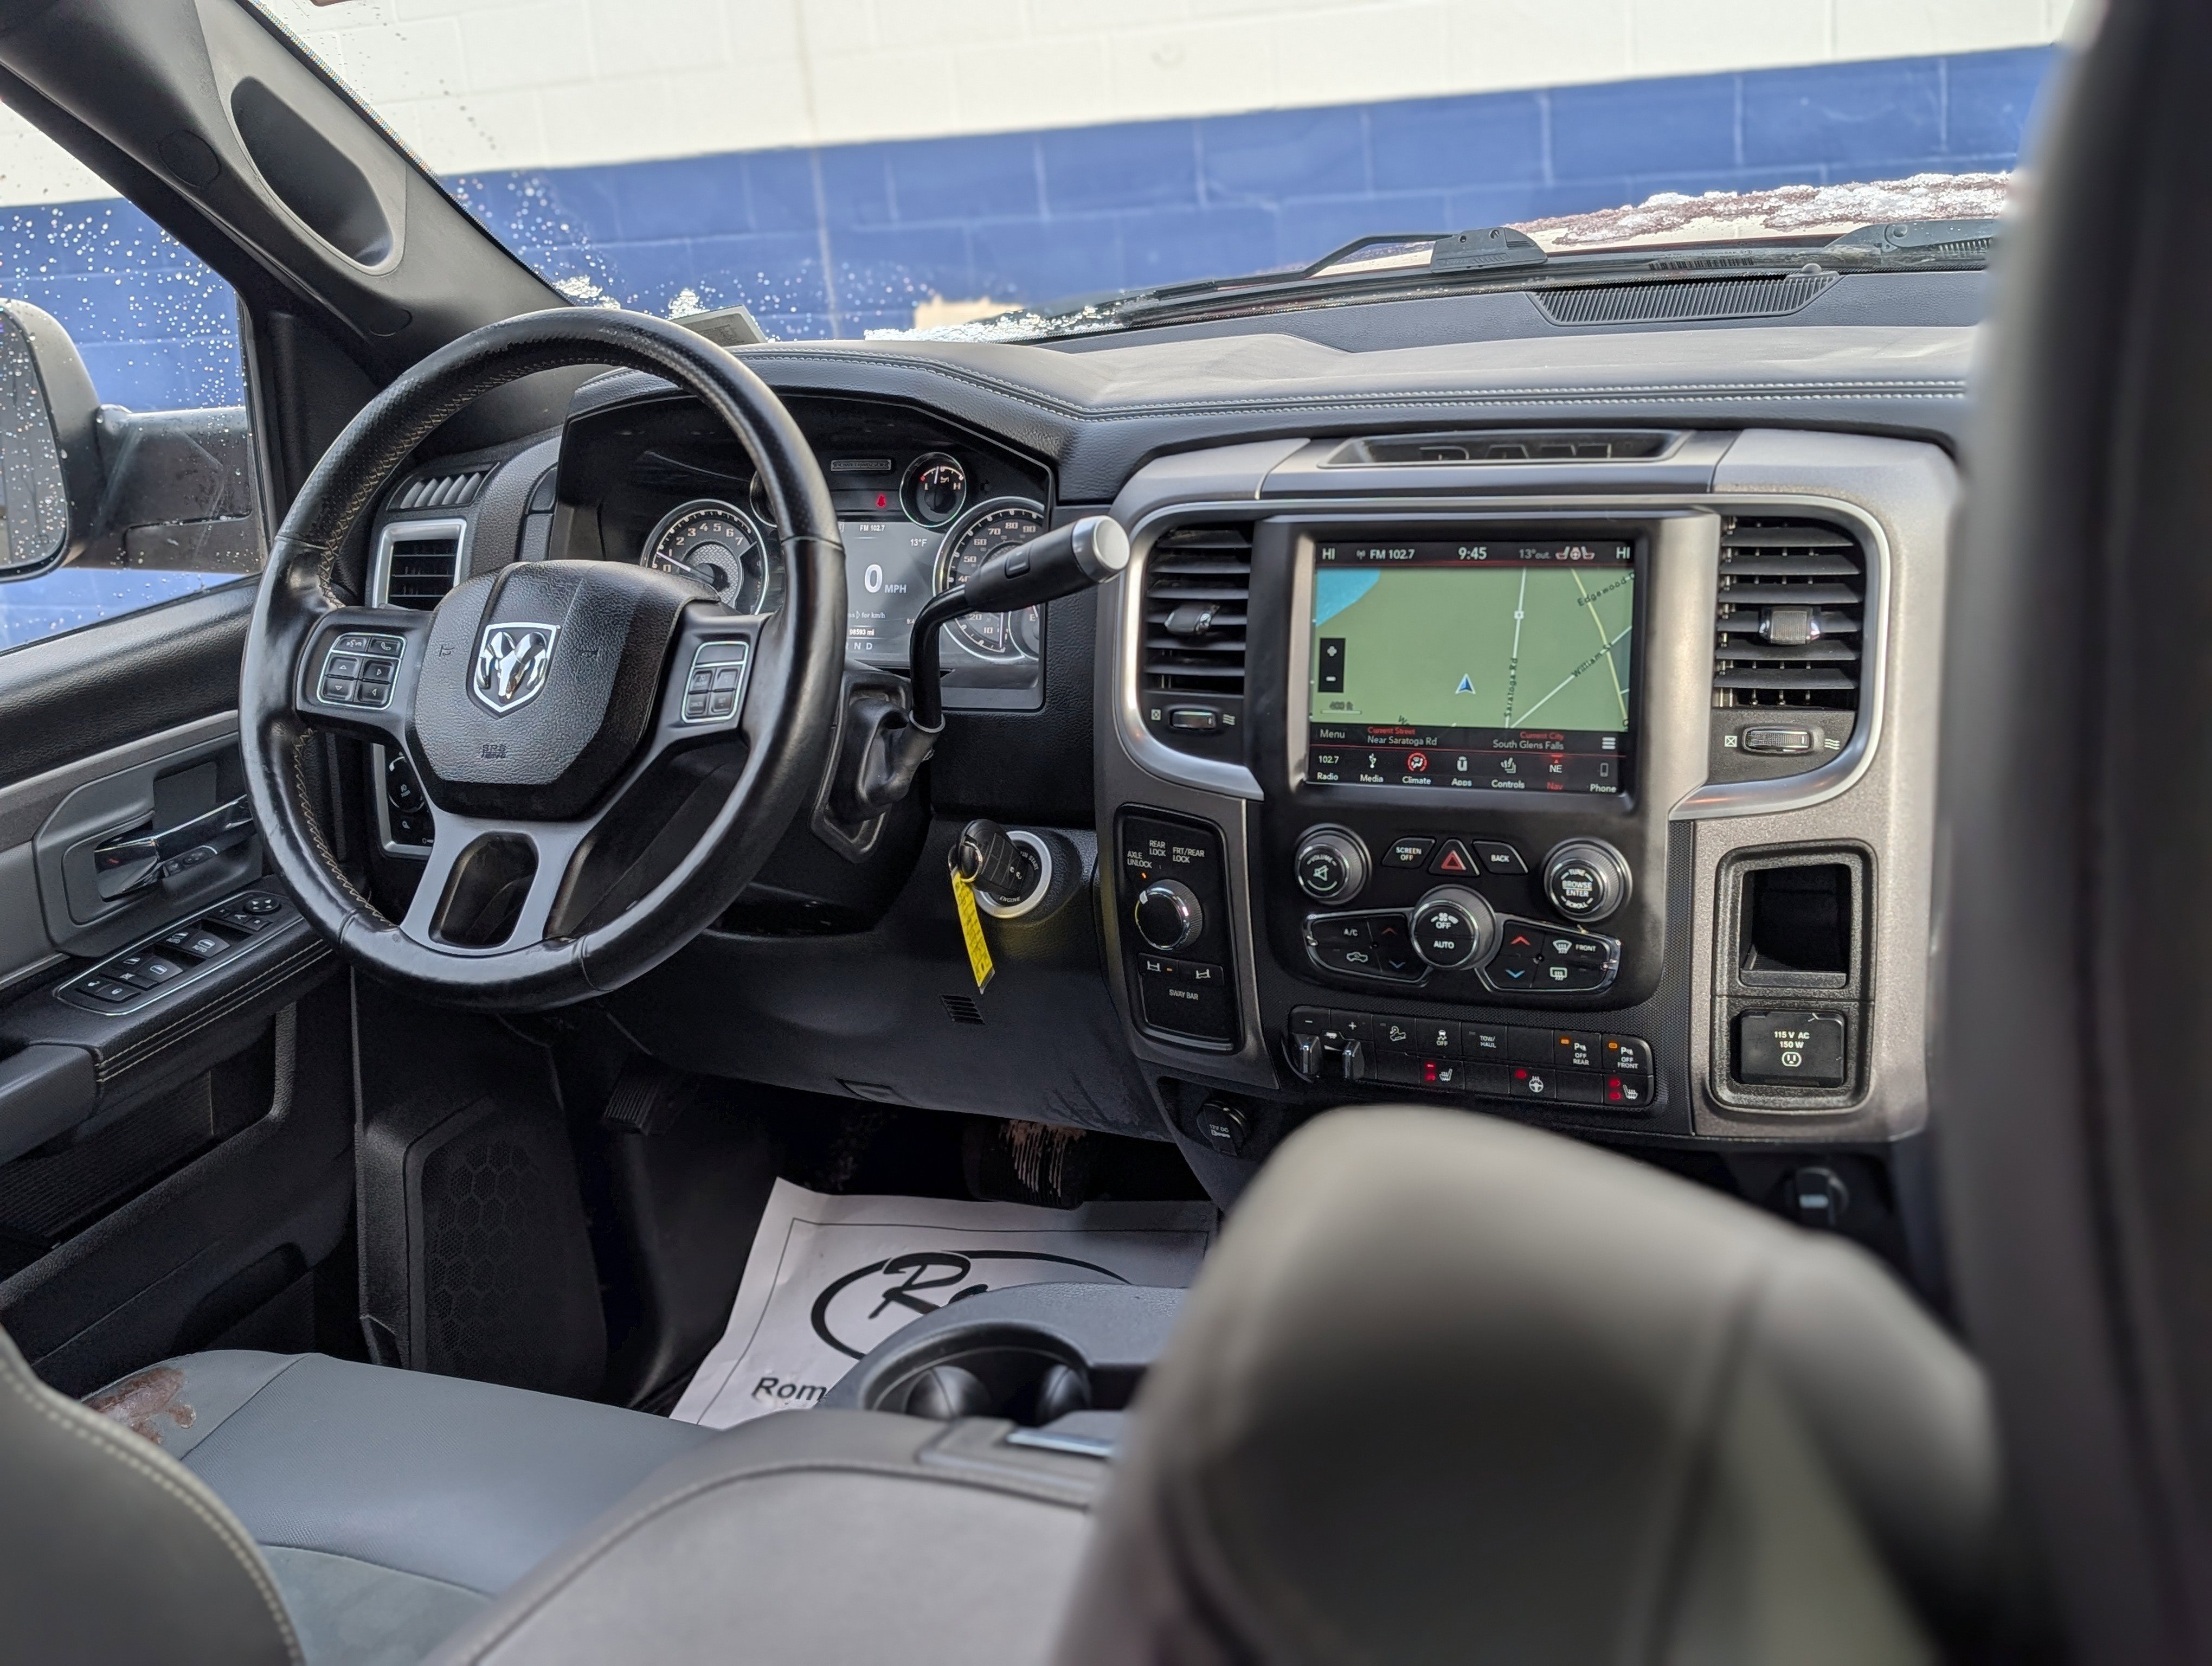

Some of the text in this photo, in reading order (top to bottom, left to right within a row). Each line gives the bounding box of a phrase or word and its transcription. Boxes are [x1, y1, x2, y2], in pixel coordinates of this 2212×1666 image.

[699, 523, 708, 531] 4
[713, 523, 722, 531] 5
[687, 528, 696, 536] 3
[726, 528, 734, 537] 6
[676, 537, 684, 546] 2
[735, 537, 743, 546] 7
[1322, 548, 1335, 560] HI
[1369, 549, 1416, 560] FM 102.7
[1458, 547, 1487, 560] 9:45
[1616, 547, 1630, 559] HI
[864, 564, 907, 593] 0 MPH
[1577, 576, 1626, 606] Edgewood
[854, 642, 861, 650] N
[866, 642, 873, 650] D
[1571, 652, 1603, 677] William
[1503, 657, 1518, 717] Saratoga Rd
[1320, 729, 1345, 739] Menu
[1367, 735, 1437, 746] Near Saratoga Rd
[1493, 739, 1564, 750] South Glens Falls
[1549, 765, 1562, 773] NE
[1317, 772, 1339, 781] Radio
[1360, 774, 1384, 783] Media
[1402, 776, 1431, 785] Climate
[1451, 778, 1472, 787] Apps
[1491, 779, 1525, 789] Controls
[1547, 782, 1564, 790] Nav
[1590, 784, 1617, 793] Phone
[1149, 840, 1166, 849] REAR
[1127, 850, 1143, 860] AXLE
[1149, 848, 1166, 857] LOCK
[1173, 847, 1205, 857] FRT/REAR
[1396, 847, 1422, 855] SCREEN
[1173, 855, 1190, 863] LOCK
[1310, 854, 1333, 863] VOLUME
[1491, 854, 1510, 862] BACK
[1127, 858, 1153, 868] UNLOCK
[1562, 880, 1593, 889] BROWSE
[1343, 927, 1358, 937] A/C
[192, 944, 208, 953] AUTO
[1433, 940, 1455, 949] AUTO
[1575, 944, 1596, 952] FRONT
[1169, 989, 1199, 1001] SWAY BAR
